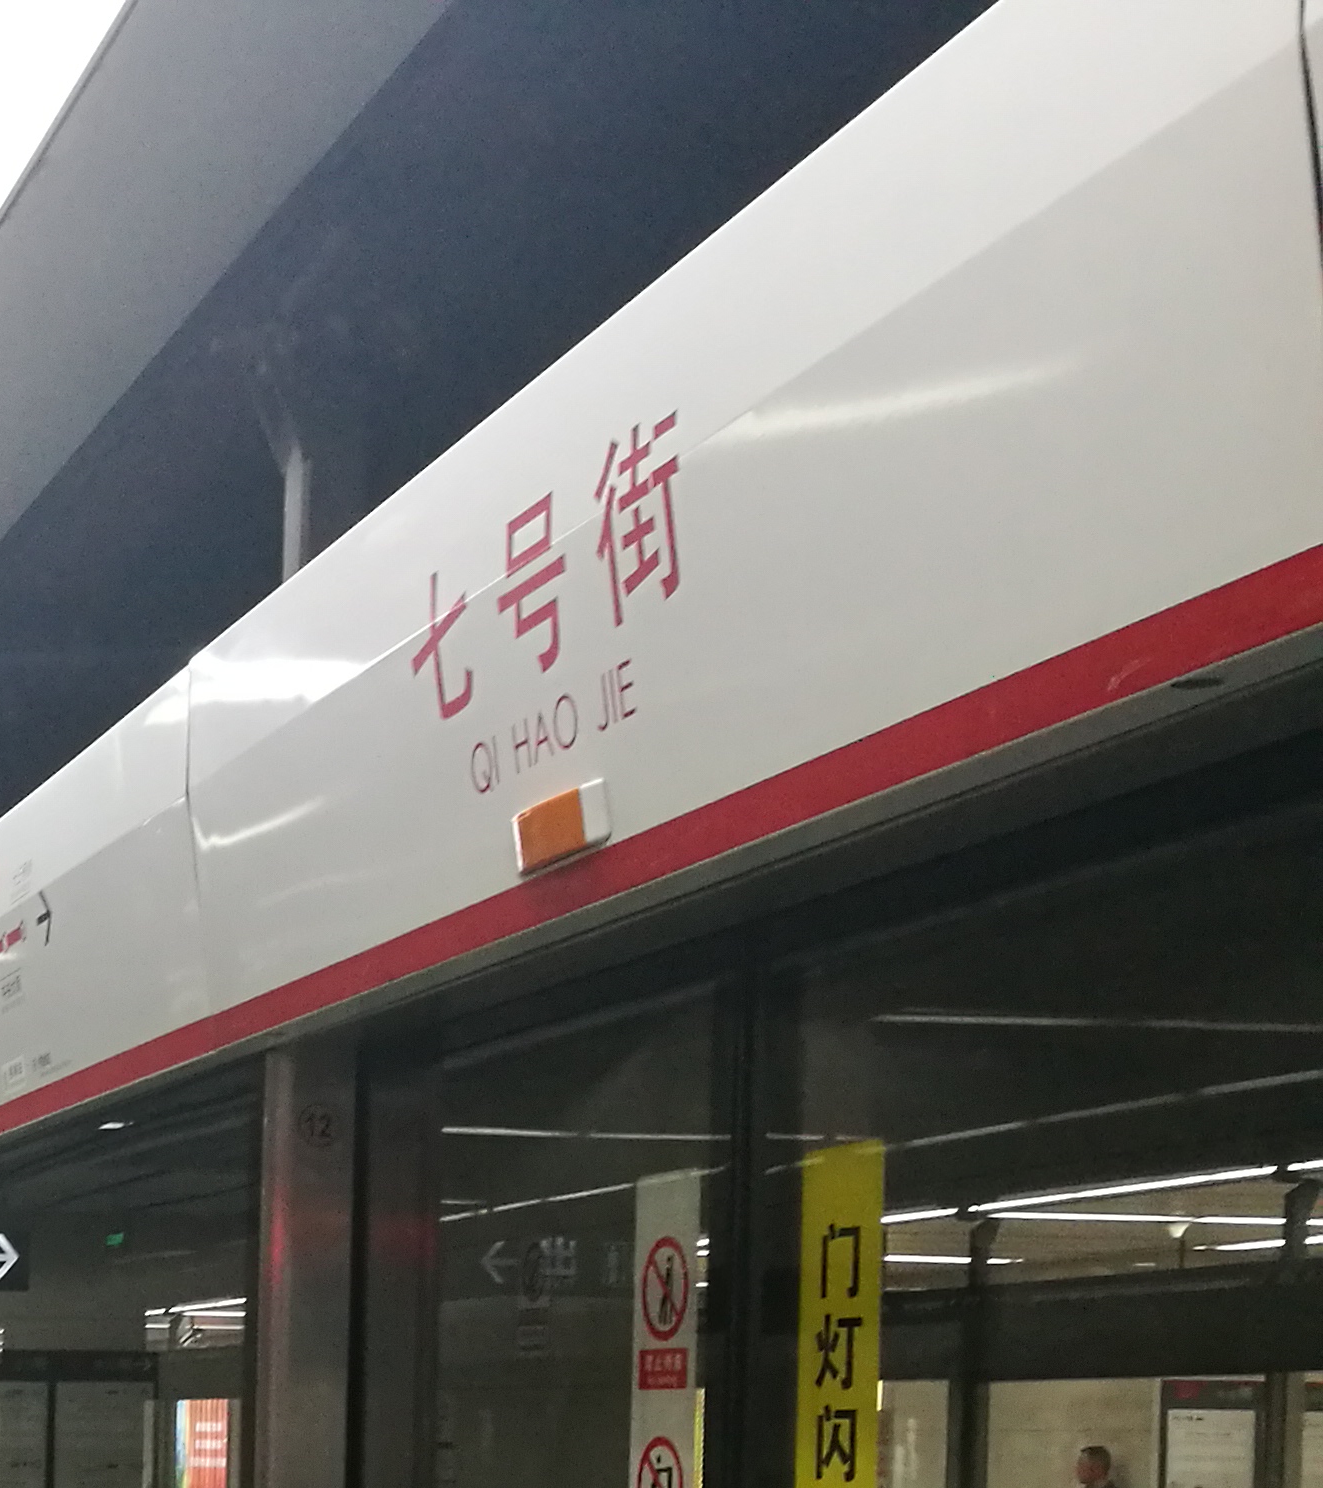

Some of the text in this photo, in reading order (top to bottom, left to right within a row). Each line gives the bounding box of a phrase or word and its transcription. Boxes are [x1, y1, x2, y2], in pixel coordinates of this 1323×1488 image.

[411, 409, 681, 721] 七号街
[470, 658, 638, 795] QI HAO JIE
